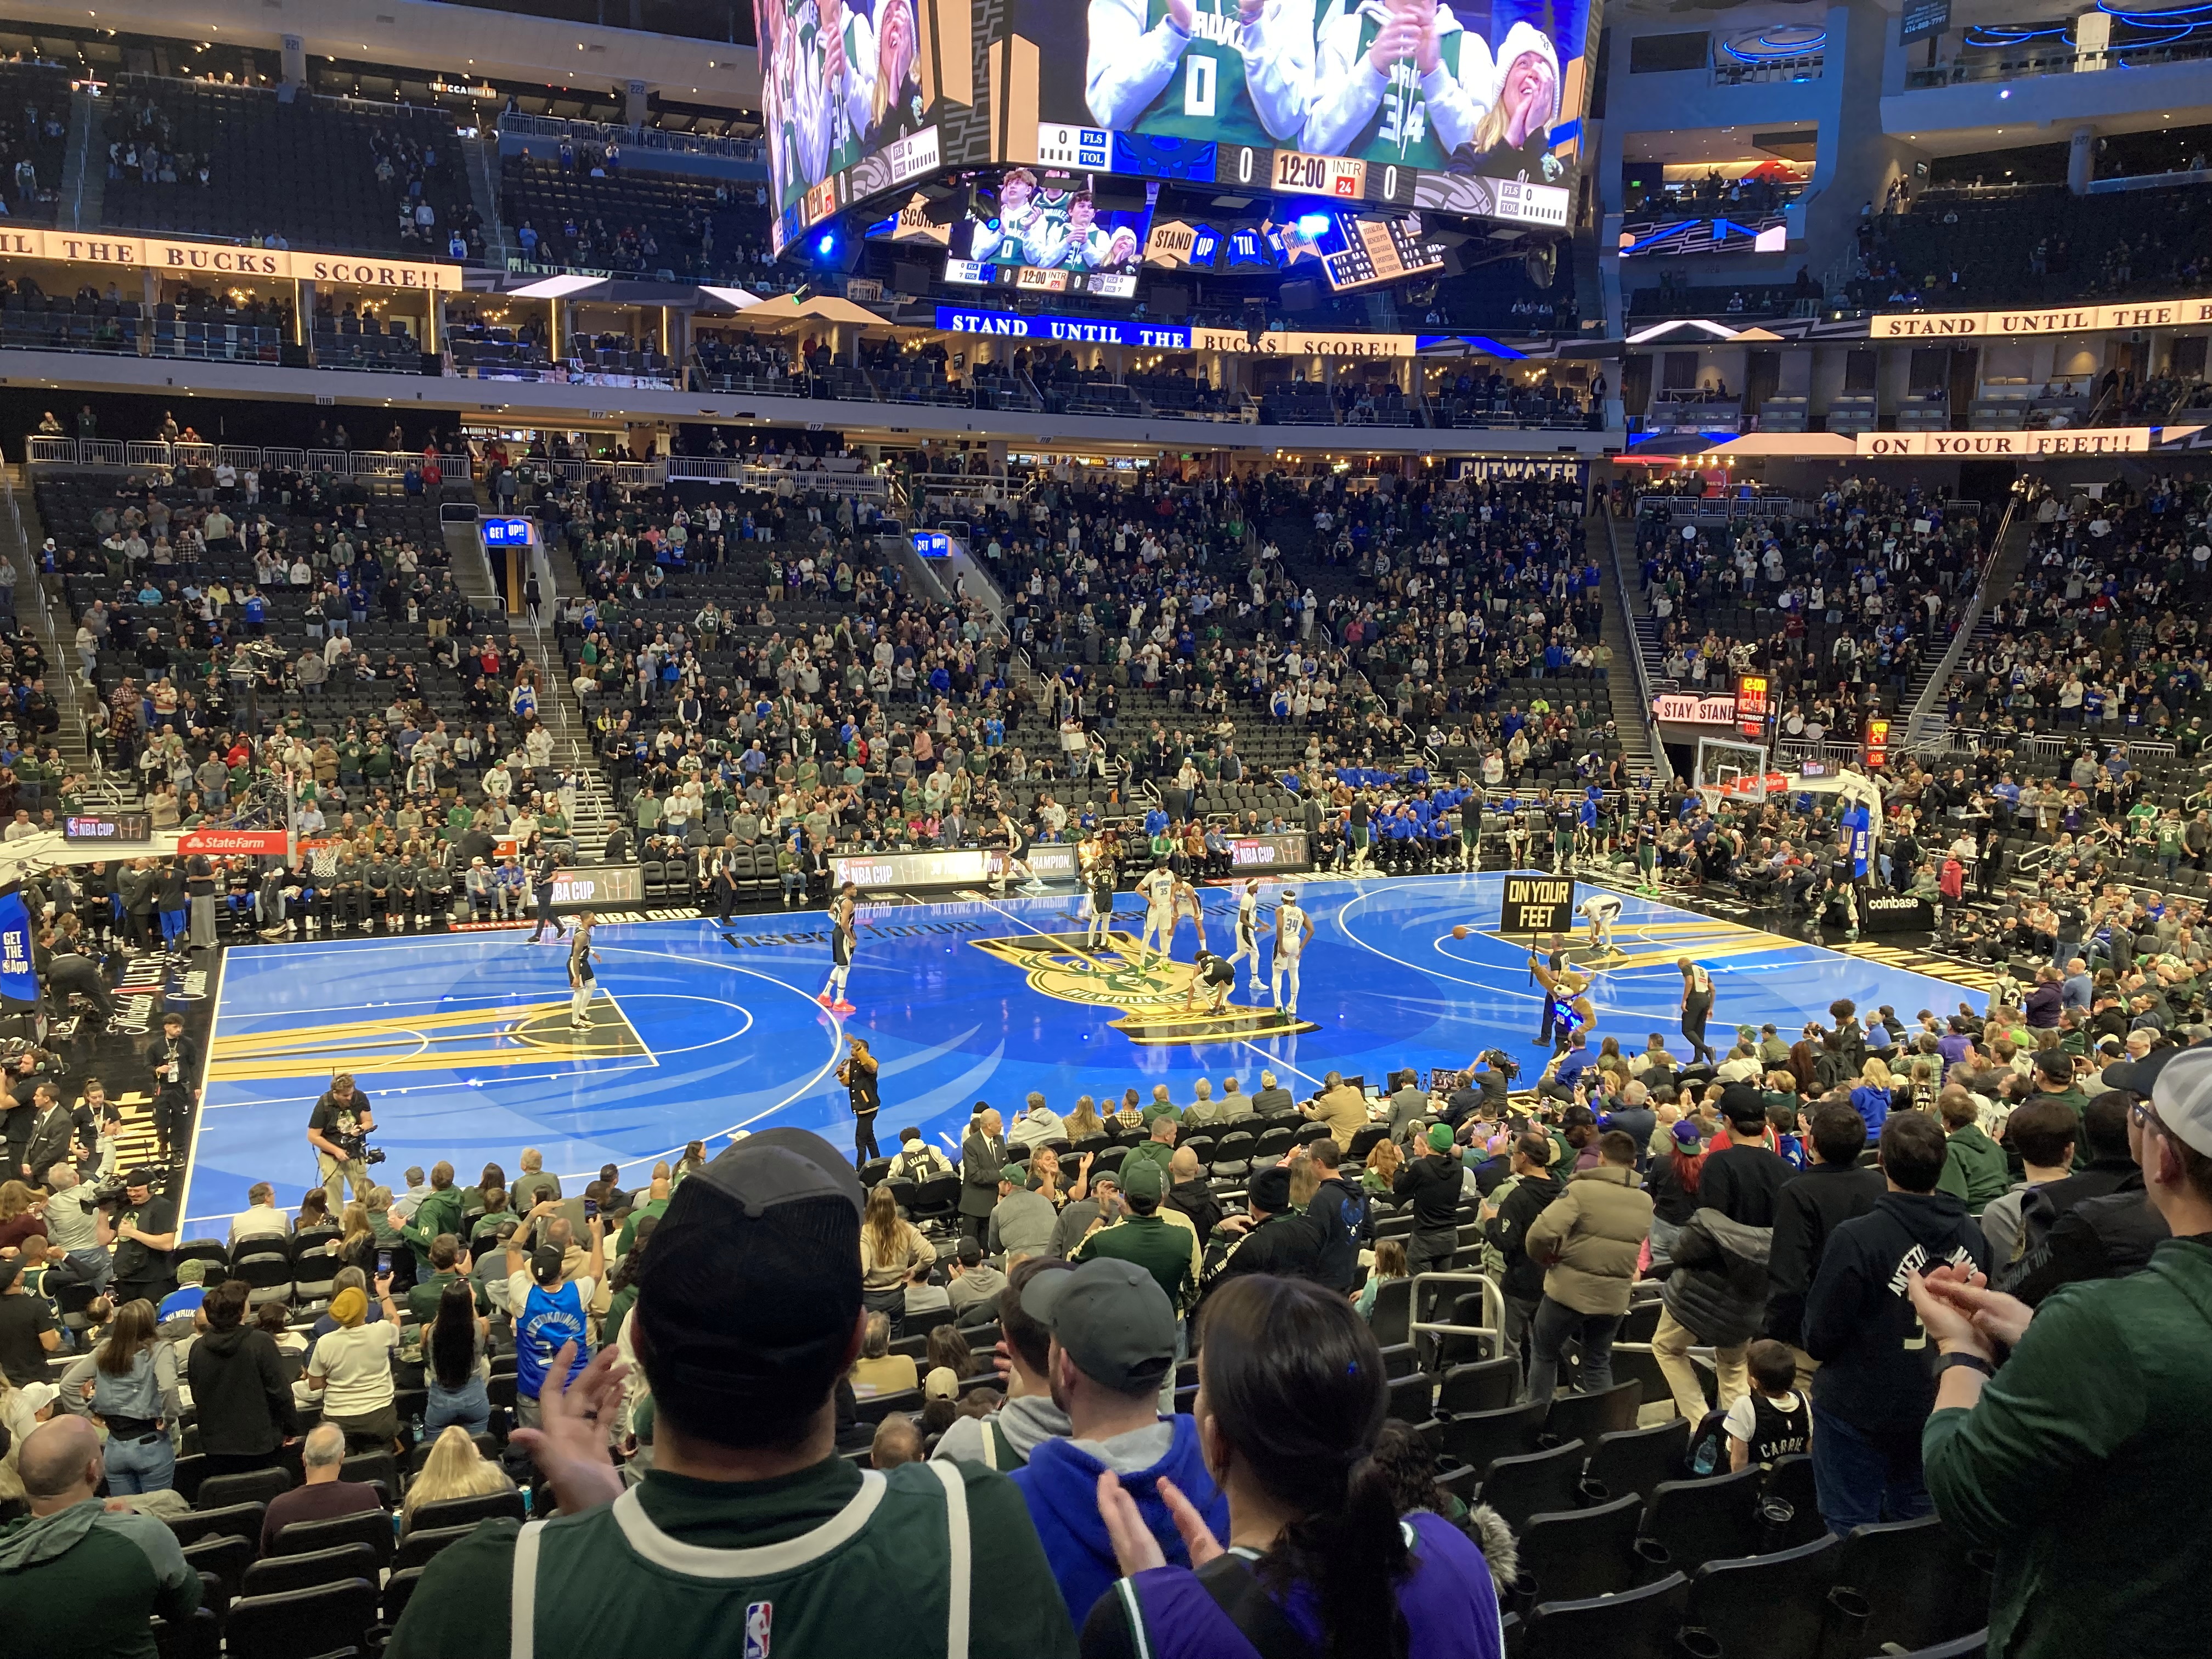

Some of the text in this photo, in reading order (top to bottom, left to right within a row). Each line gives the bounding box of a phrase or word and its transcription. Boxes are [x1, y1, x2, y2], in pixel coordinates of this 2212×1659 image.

[630, 84, 645, 95] 222
[1184, 54, 1217, 116] 0
[1058, 129, 1103, 144] 0 FLS
[1081, 153, 1104, 164] TOL
[1239, 147, 1397, 199] 0 12:00 INTR 0
[839, 171, 847, 204] 0
[1338, 181, 1352, 194] 24
[1504, 185, 1532, 201] FLS 0
[1502, 203, 1518, 213] TOL
[1001, 240, 1014, 258] 0
[1155, 229, 1192, 250] STAND
[1197, 237, 1214, 256] UP
[1233, 235, 1255, 256] 'TIL
[1268, 232, 1284, 251] WE
[63, 239, 134, 262] THE
[166, 247, 276, 274] BUCKS
[314, 262, 439, 289] SCORE!!
[1003, 269, 1082, 289] 0 12:00 INTR 0
[1889, 318, 1976, 335] STAND
[2002, 312, 2089, 331] UNTIL
[2113, 307, 2171, 326] THE
[952, 315, 1028, 336] STAND
[1051, 321, 1122, 343] UNTIL
[1140, 330, 1184, 348] THE
[1304, 340, 1398, 356] SCORE!!
[1872, 435, 2131, 454] ON YOUR FEET!!
[489, 524, 524, 539] GET UP!!
[917, 538, 945, 551] GET UP!!
[1743, 678, 1766, 691] 12:00
[1664, 702, 1692, 718] STAY
[1871, 732, 1884, 743] 24
[79, 822, 115, 837] NBA CUP
[2164, 832, 2172, 842] 0
[499, 842, 507, 851] G
[1238, 846, 1276, 864] NBA CUP
[851, 865, 893, 884] NBA CUP
[571, 881, 595, 900] CUP
[1508, 881, 1532, 903] ON
[1532, 881, 1568, 904] YOUR
[1869, 895, 1919, 910] coinbase
[646, 907, 702, 921] CUP
[1519, 905, 1555, 928] FEET
[1286, 918, 1299, 932] 34
[3, 931, 22, 945] GET
[4, 945, 24, 959] THE
[11, 961, 29, 975] App
[1059, 987, 1183, 1005] MILWAUKEE
[907, 1154, 930, 1167] LILLARD
